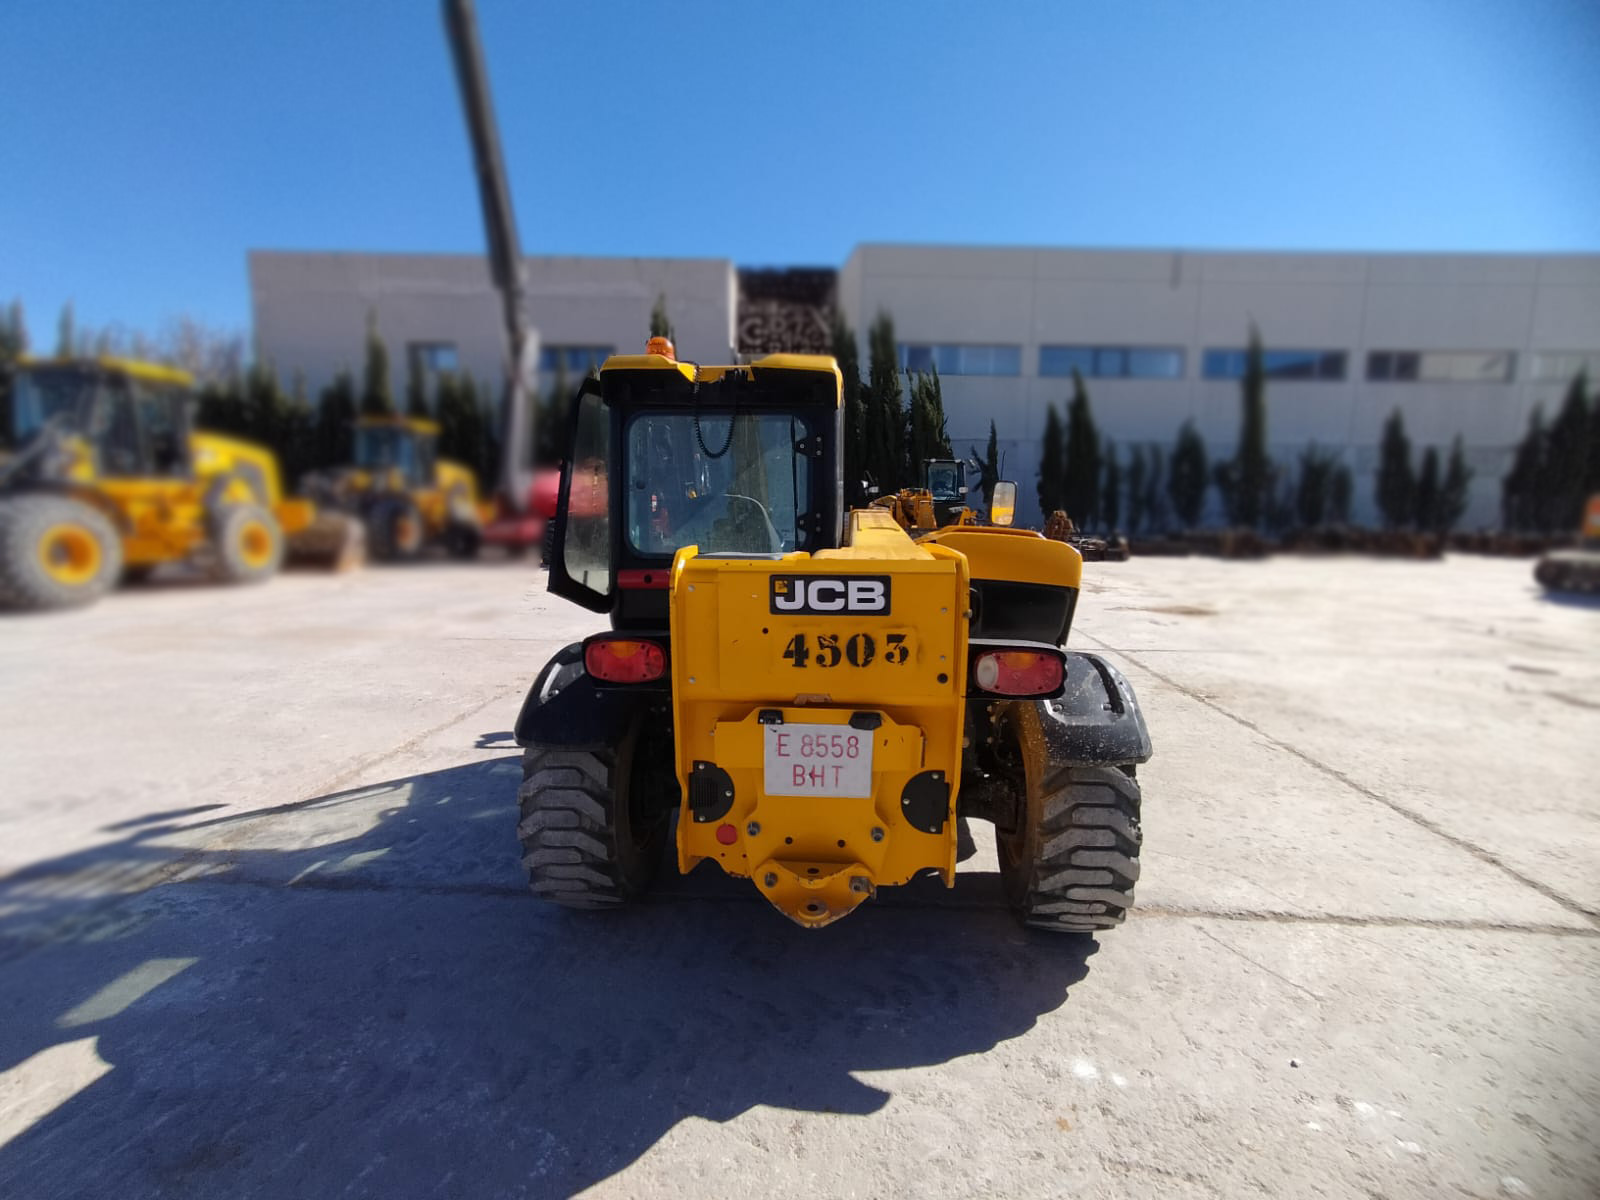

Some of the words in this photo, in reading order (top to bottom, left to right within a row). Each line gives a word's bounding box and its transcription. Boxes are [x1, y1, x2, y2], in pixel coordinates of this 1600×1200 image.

[775, 580, 886, 611] JCB
[783, 634, 910, 667] 4503
[777, 733, 791, 757] E
[800, 734, 860, 758] 8558
[793, 764, 844, 788] BHT
